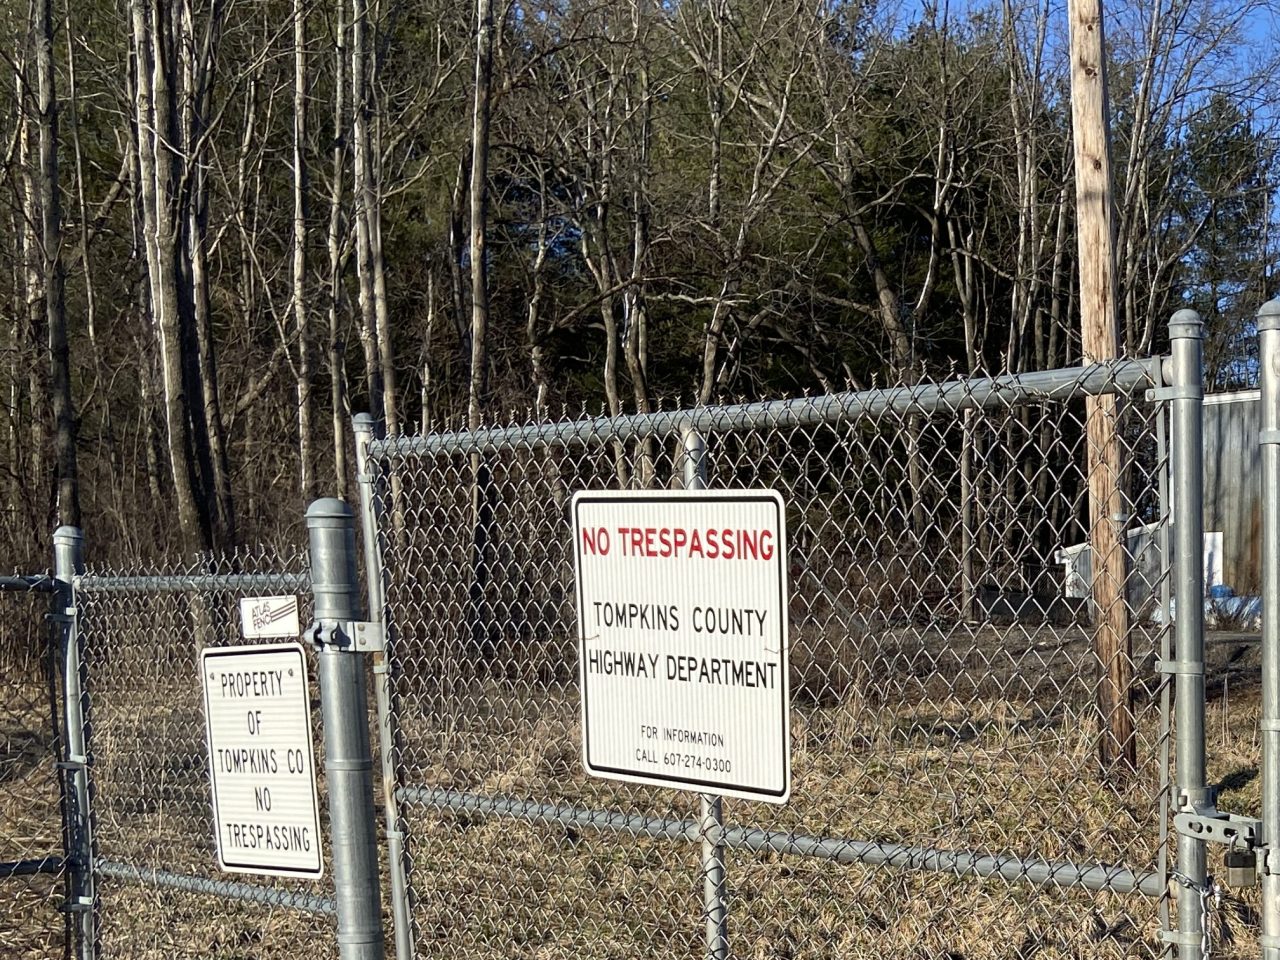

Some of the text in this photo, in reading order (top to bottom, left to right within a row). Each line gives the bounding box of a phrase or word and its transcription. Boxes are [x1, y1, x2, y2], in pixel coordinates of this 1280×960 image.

[583, 527, 774, 561] NO TRESPASSING
[593, 602, 767, 637] TOMPKINS COUNTY
[589, 649, 777, 689] HIGHWAY DEPARTMENT
[221, 670, 282, 697] PROPERTY
[247, 710, 261, 735] OF
[641, 725, 724, 747] FOR INFORMATION
[217, 748, 304, 774] TOMPKINS CO
[636, 748, 732, 773] CALL 607-274-0300
[255, 787, 271, 812] NO
[226, 823, 310, 851] TRESPASSING
